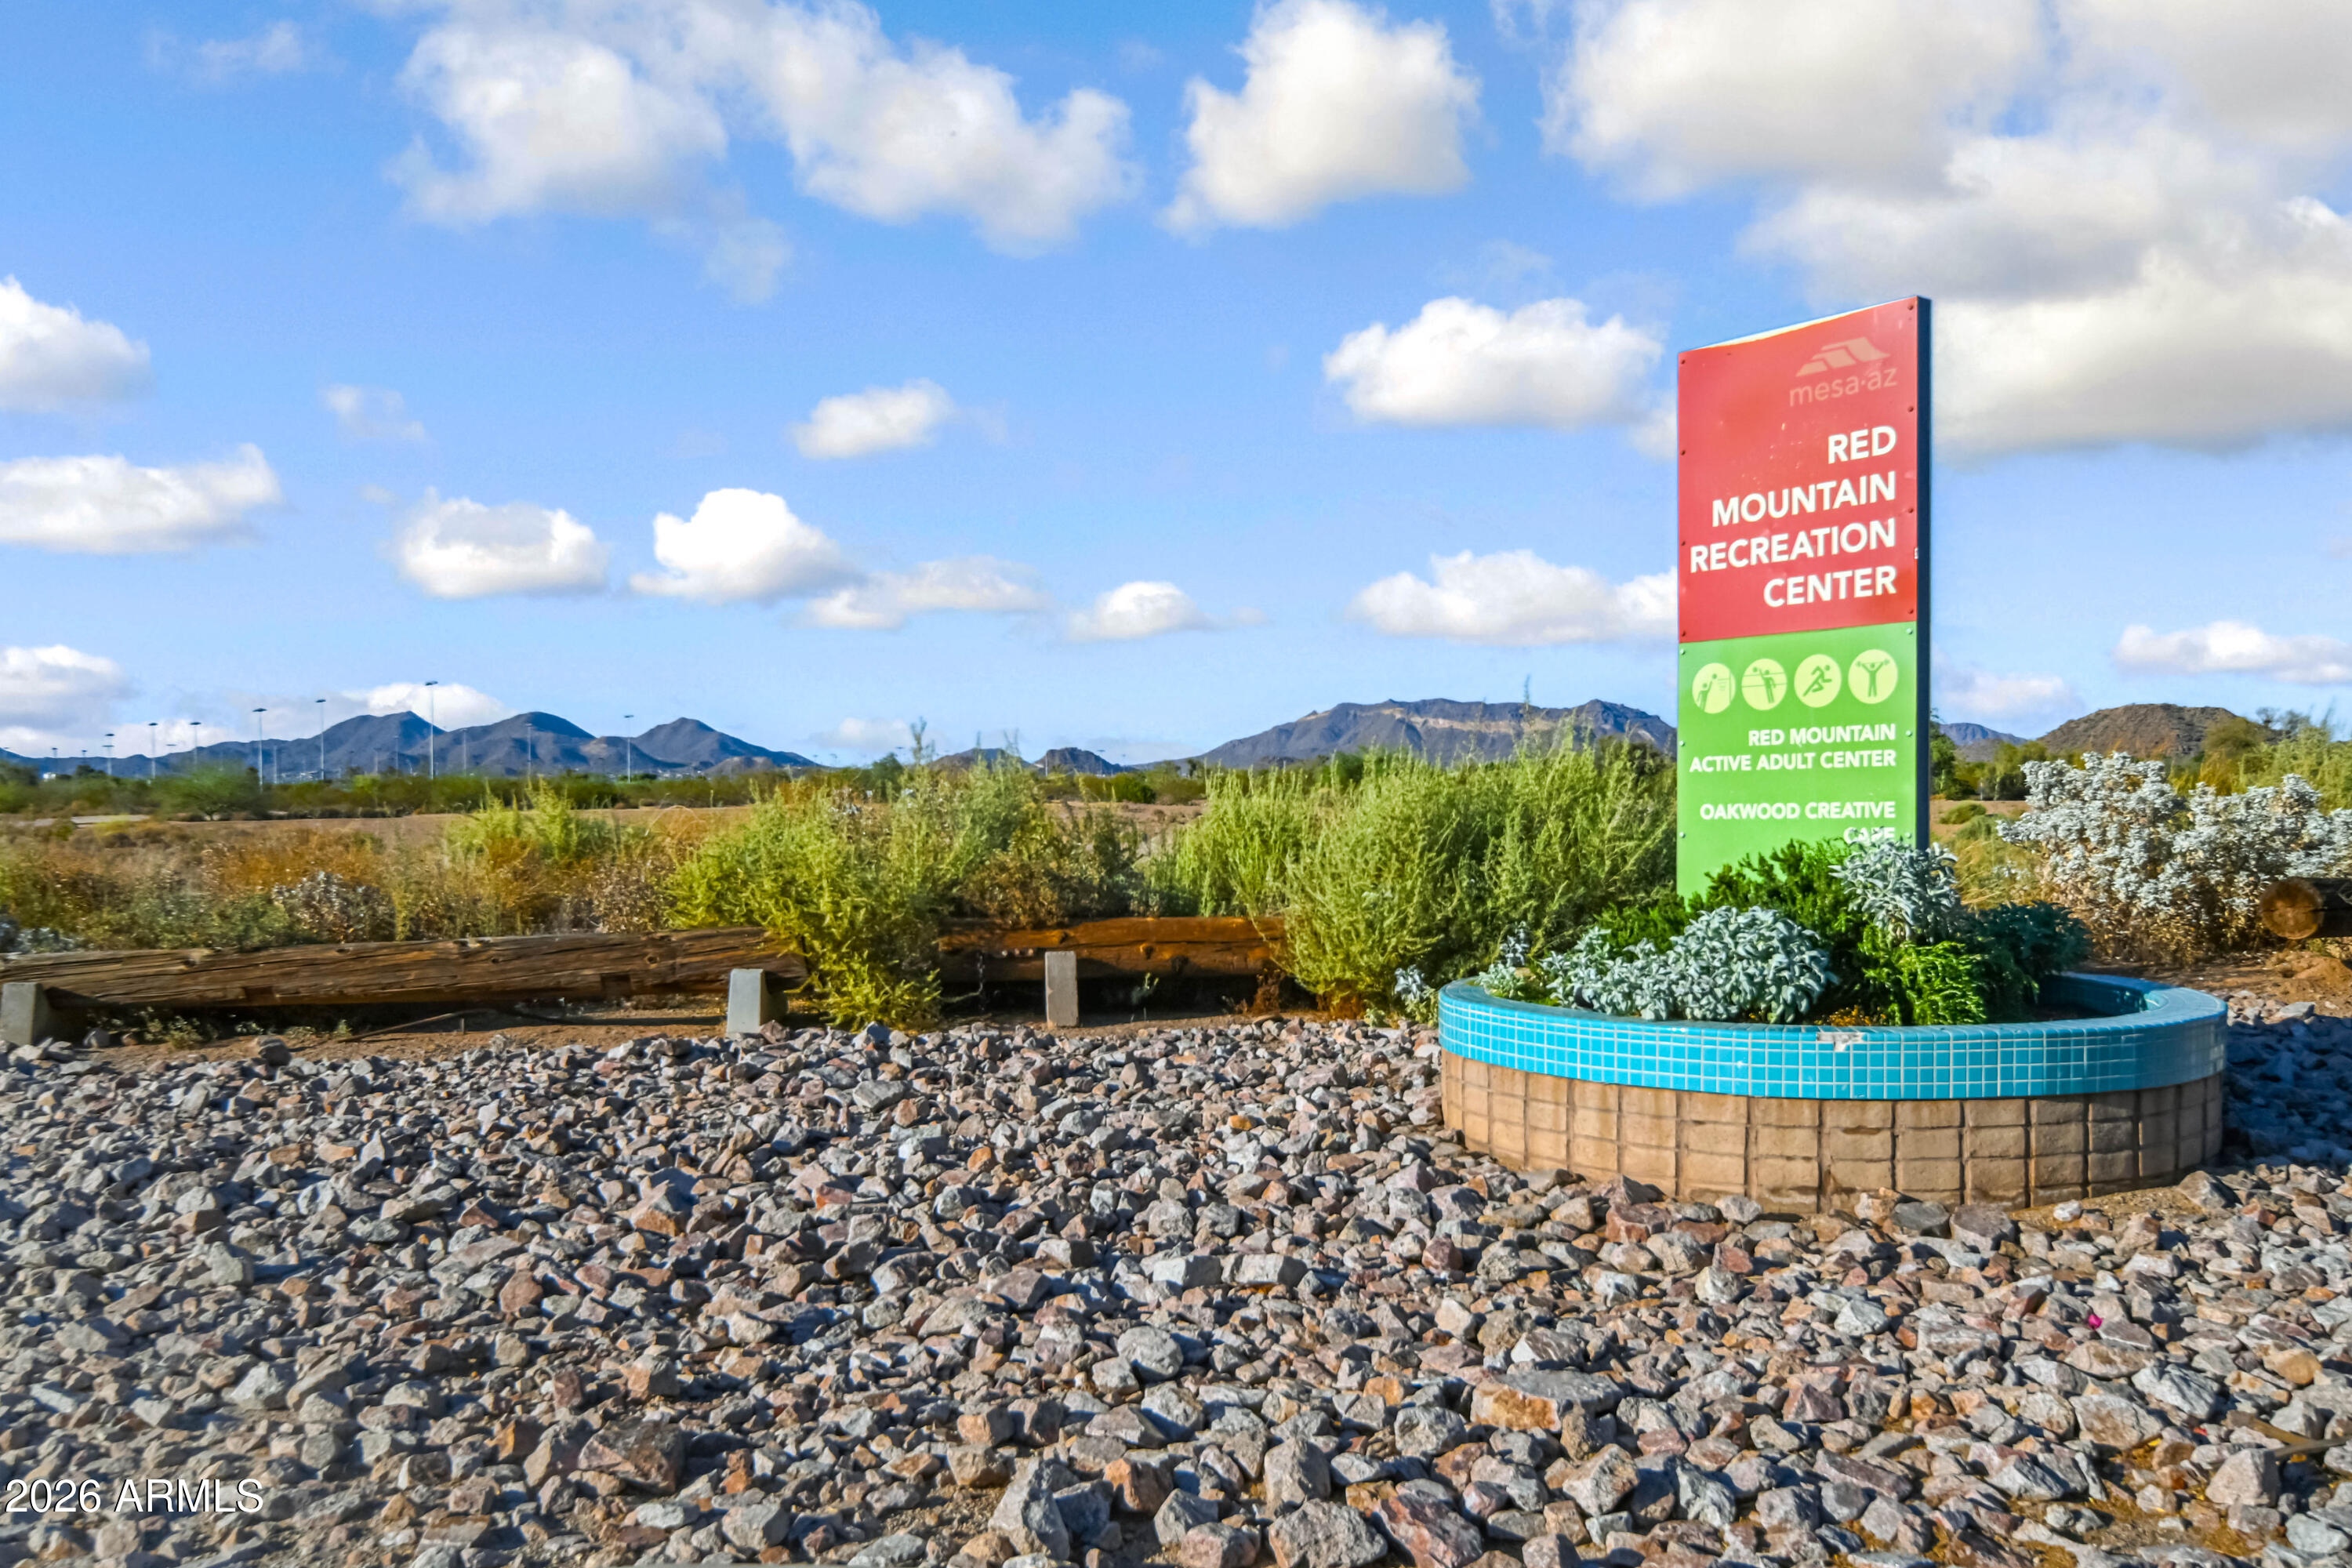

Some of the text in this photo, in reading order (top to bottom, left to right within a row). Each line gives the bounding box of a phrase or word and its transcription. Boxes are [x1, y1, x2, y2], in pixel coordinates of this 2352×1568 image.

[1828, 425, 1897, 464] RED
[1711, 470, 1896, 528] MOUNTAIN
[1690, 517, 1896, 573] RECREATION
[1763, 565, 1897, 608] CENTER
[1748, 724, 1896, 746] RED MOUNTAIN
[1689, 750, 1896, 772] ACTIVE ADULT CENTER
[1700, 801, 1896, 820] OAKWOOD CREATIVE
